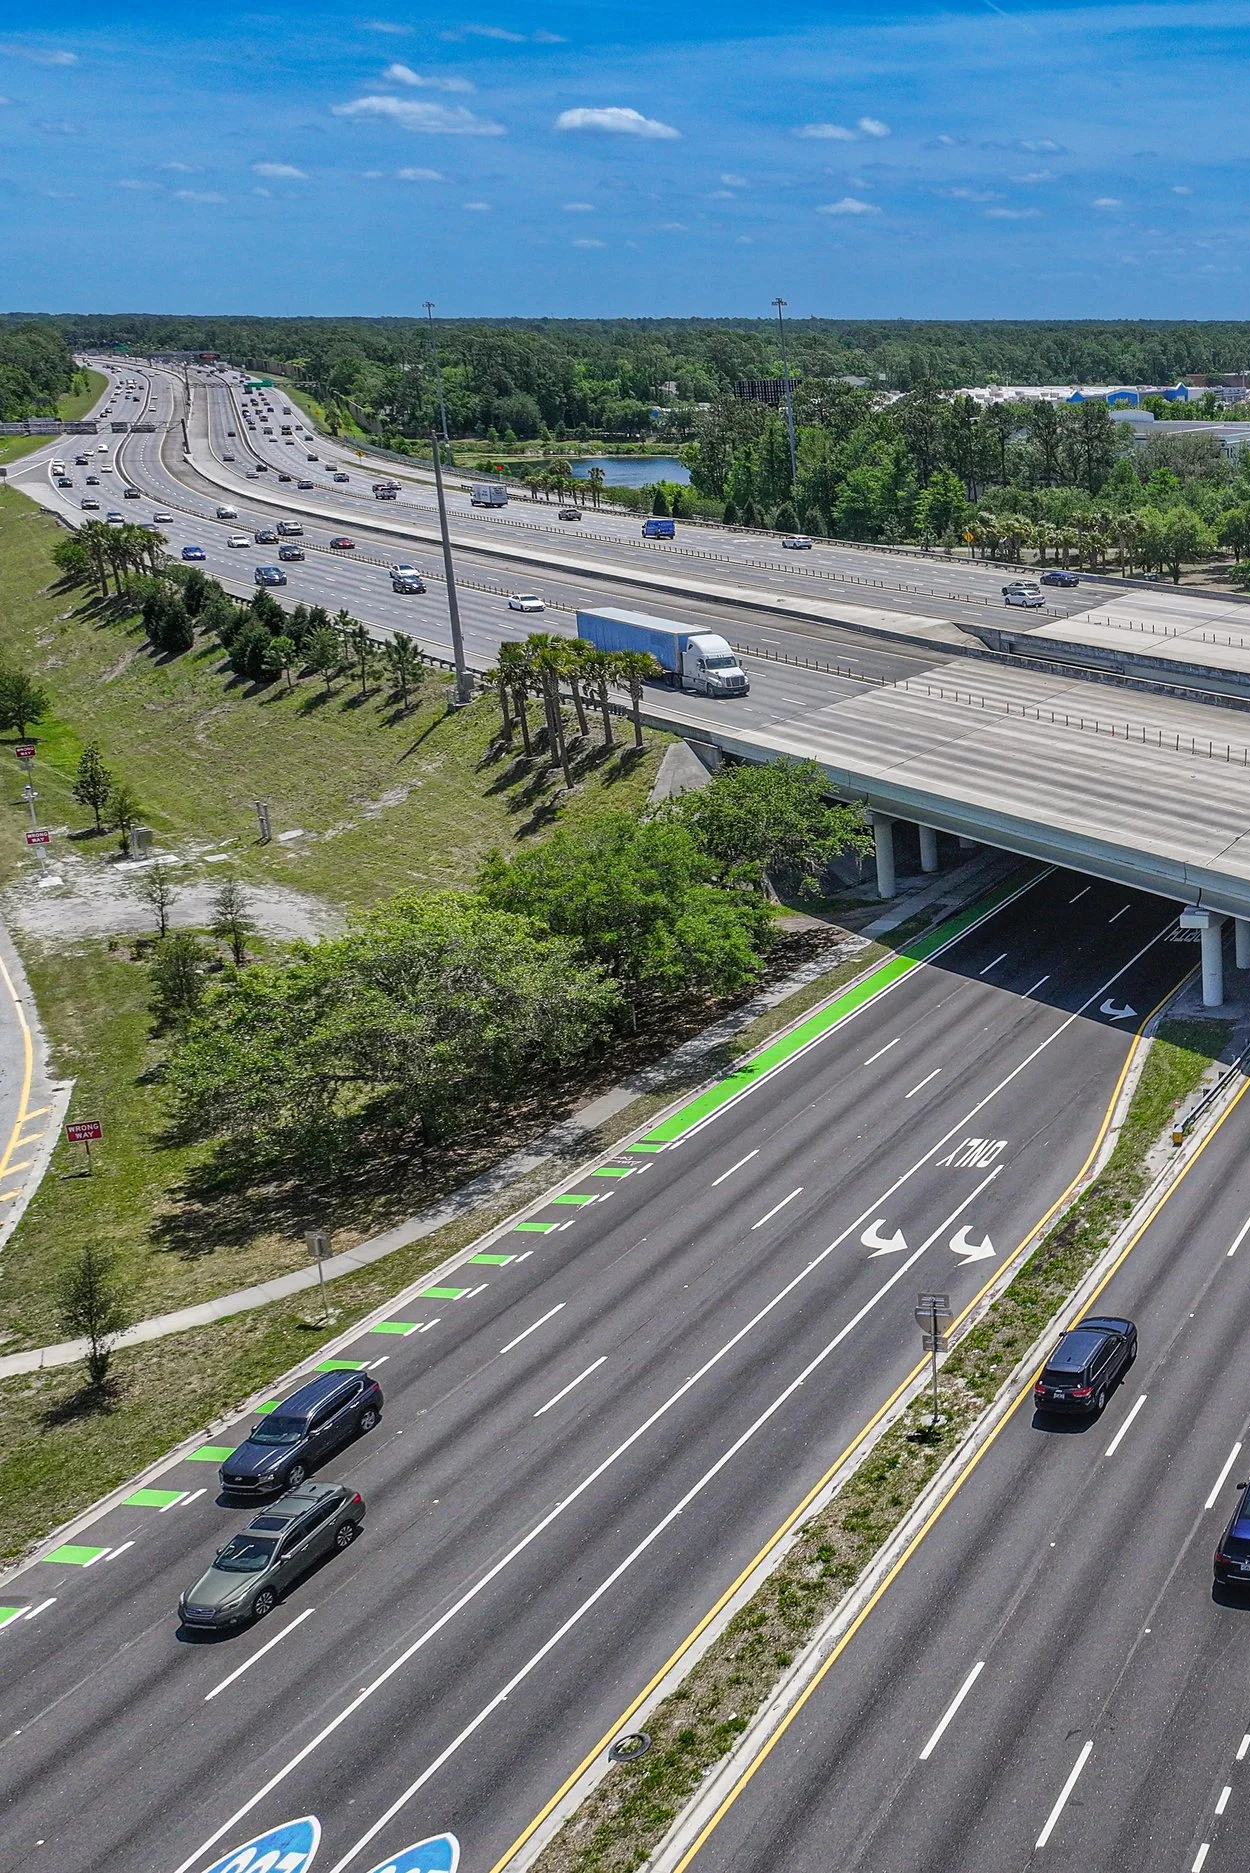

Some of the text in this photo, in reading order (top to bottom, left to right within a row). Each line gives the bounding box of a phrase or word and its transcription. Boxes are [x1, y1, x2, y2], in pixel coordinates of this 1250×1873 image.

[68, 1123, 99, 1132] WRONG
[75, 1131, 94, 1139] WAY
[935, 1138, 1008, 1168] ONLY
